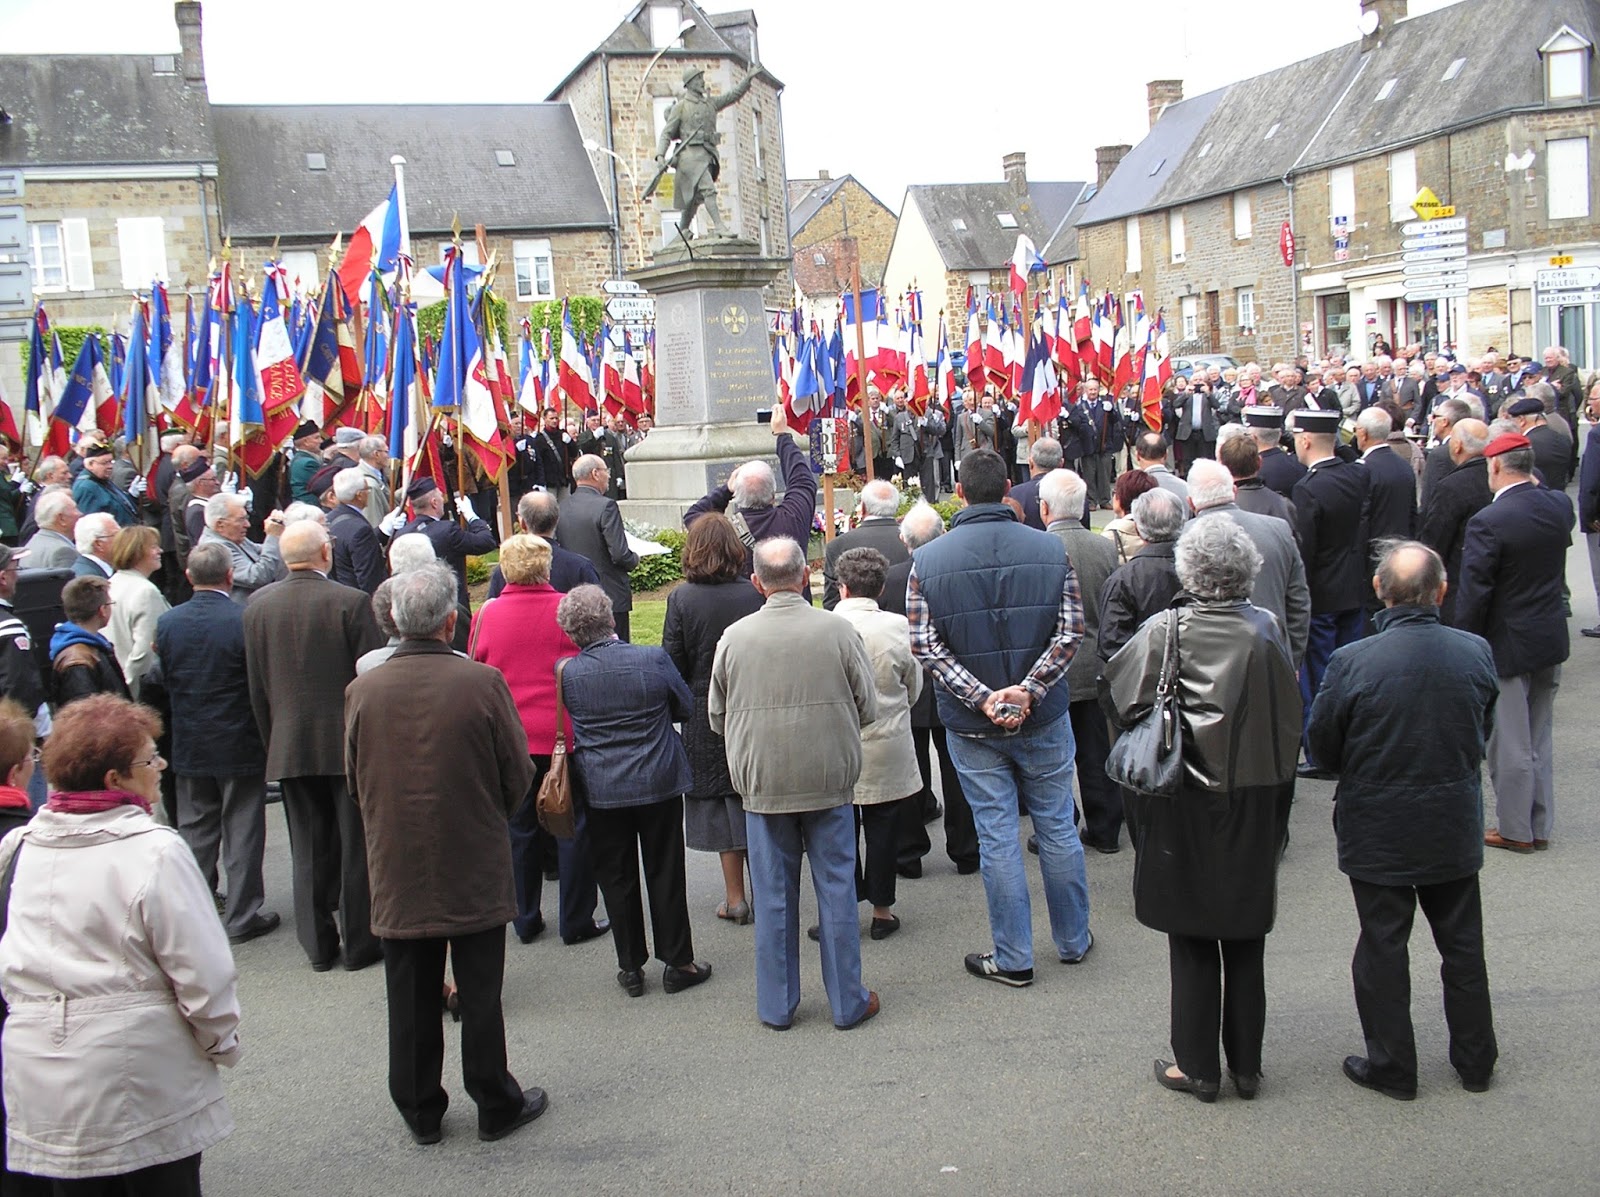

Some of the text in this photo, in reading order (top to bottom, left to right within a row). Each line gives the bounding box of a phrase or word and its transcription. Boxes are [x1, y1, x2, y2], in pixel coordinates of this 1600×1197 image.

[1422, 221, 1463, 231] MANTILLY
[1284, 227, 1294, 261] TABAC
[1552, 271, 1567, 279] CYR
[1540, 279, 1580, 288] BAILLEUL
[1541, 294, 1582, 304] BARENTON
